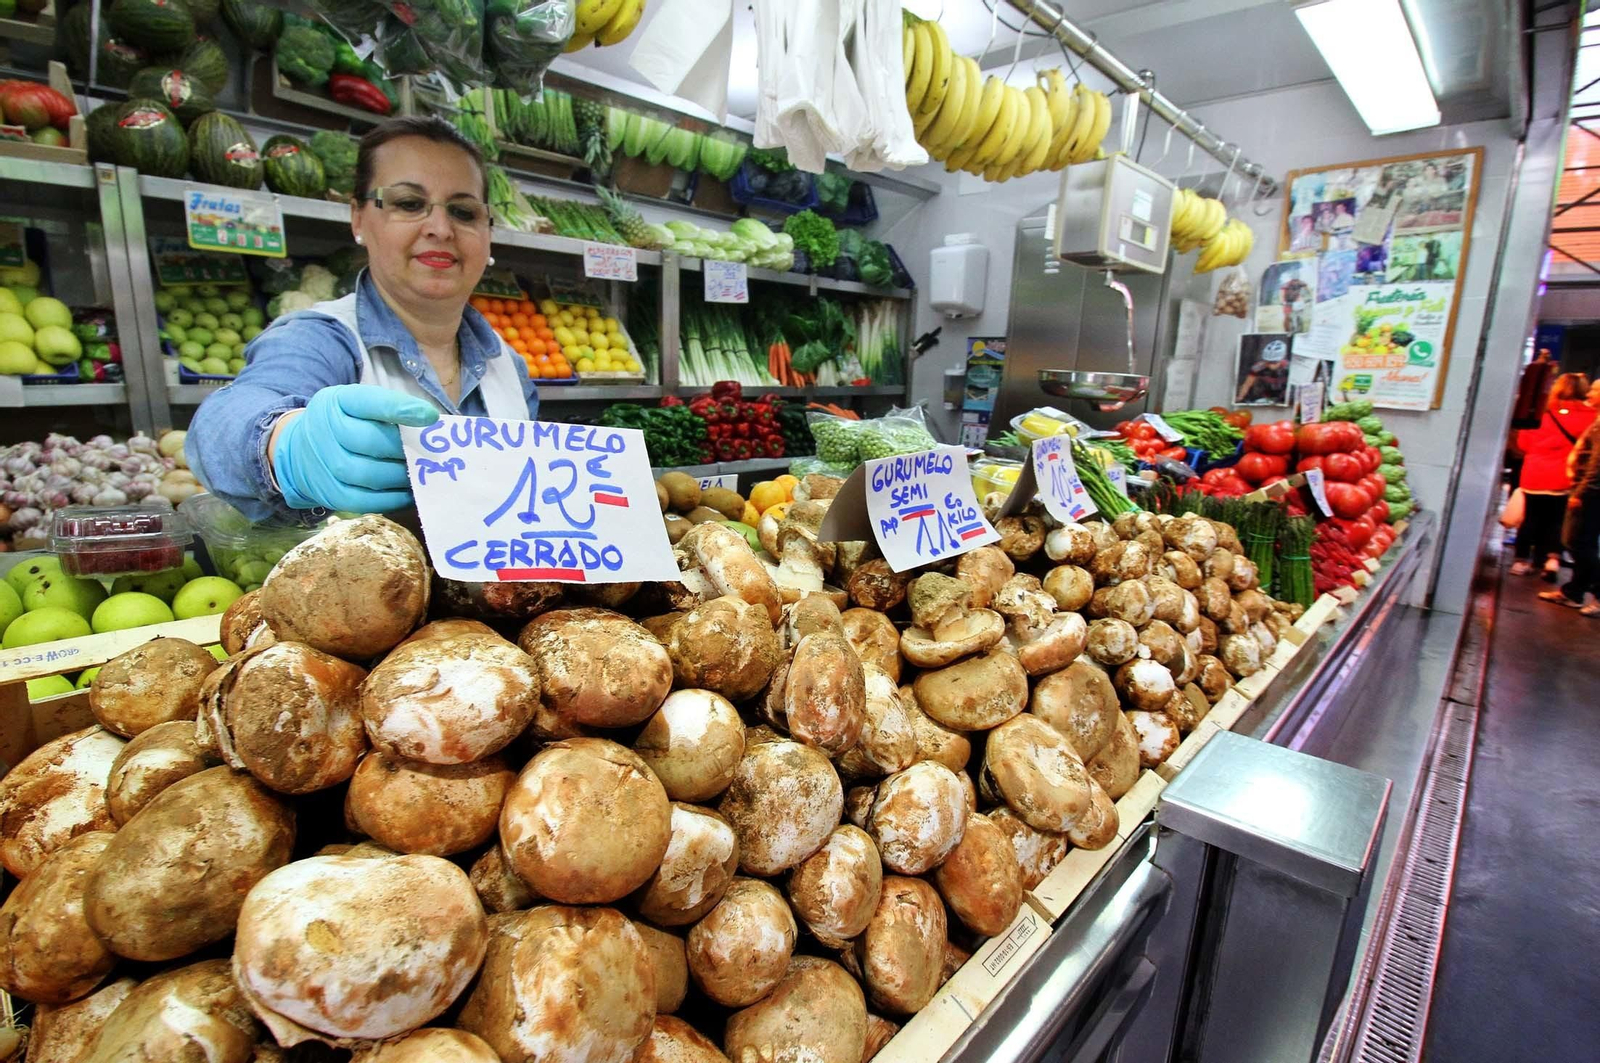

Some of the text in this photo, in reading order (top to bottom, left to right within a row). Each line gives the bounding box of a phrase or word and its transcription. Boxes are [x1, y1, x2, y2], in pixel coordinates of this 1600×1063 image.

[190, 192, 241, 214] Frutas
[419, 417, 627, 454] GURUMELO
[871, 452, 953, 493] GURUMELO
[483, 456, 596, 531] 12
[890, 483, 928, 509] SEMI
[947, 506, 977, 529] KILO
[444, 538, 624, 571] CERRADO
